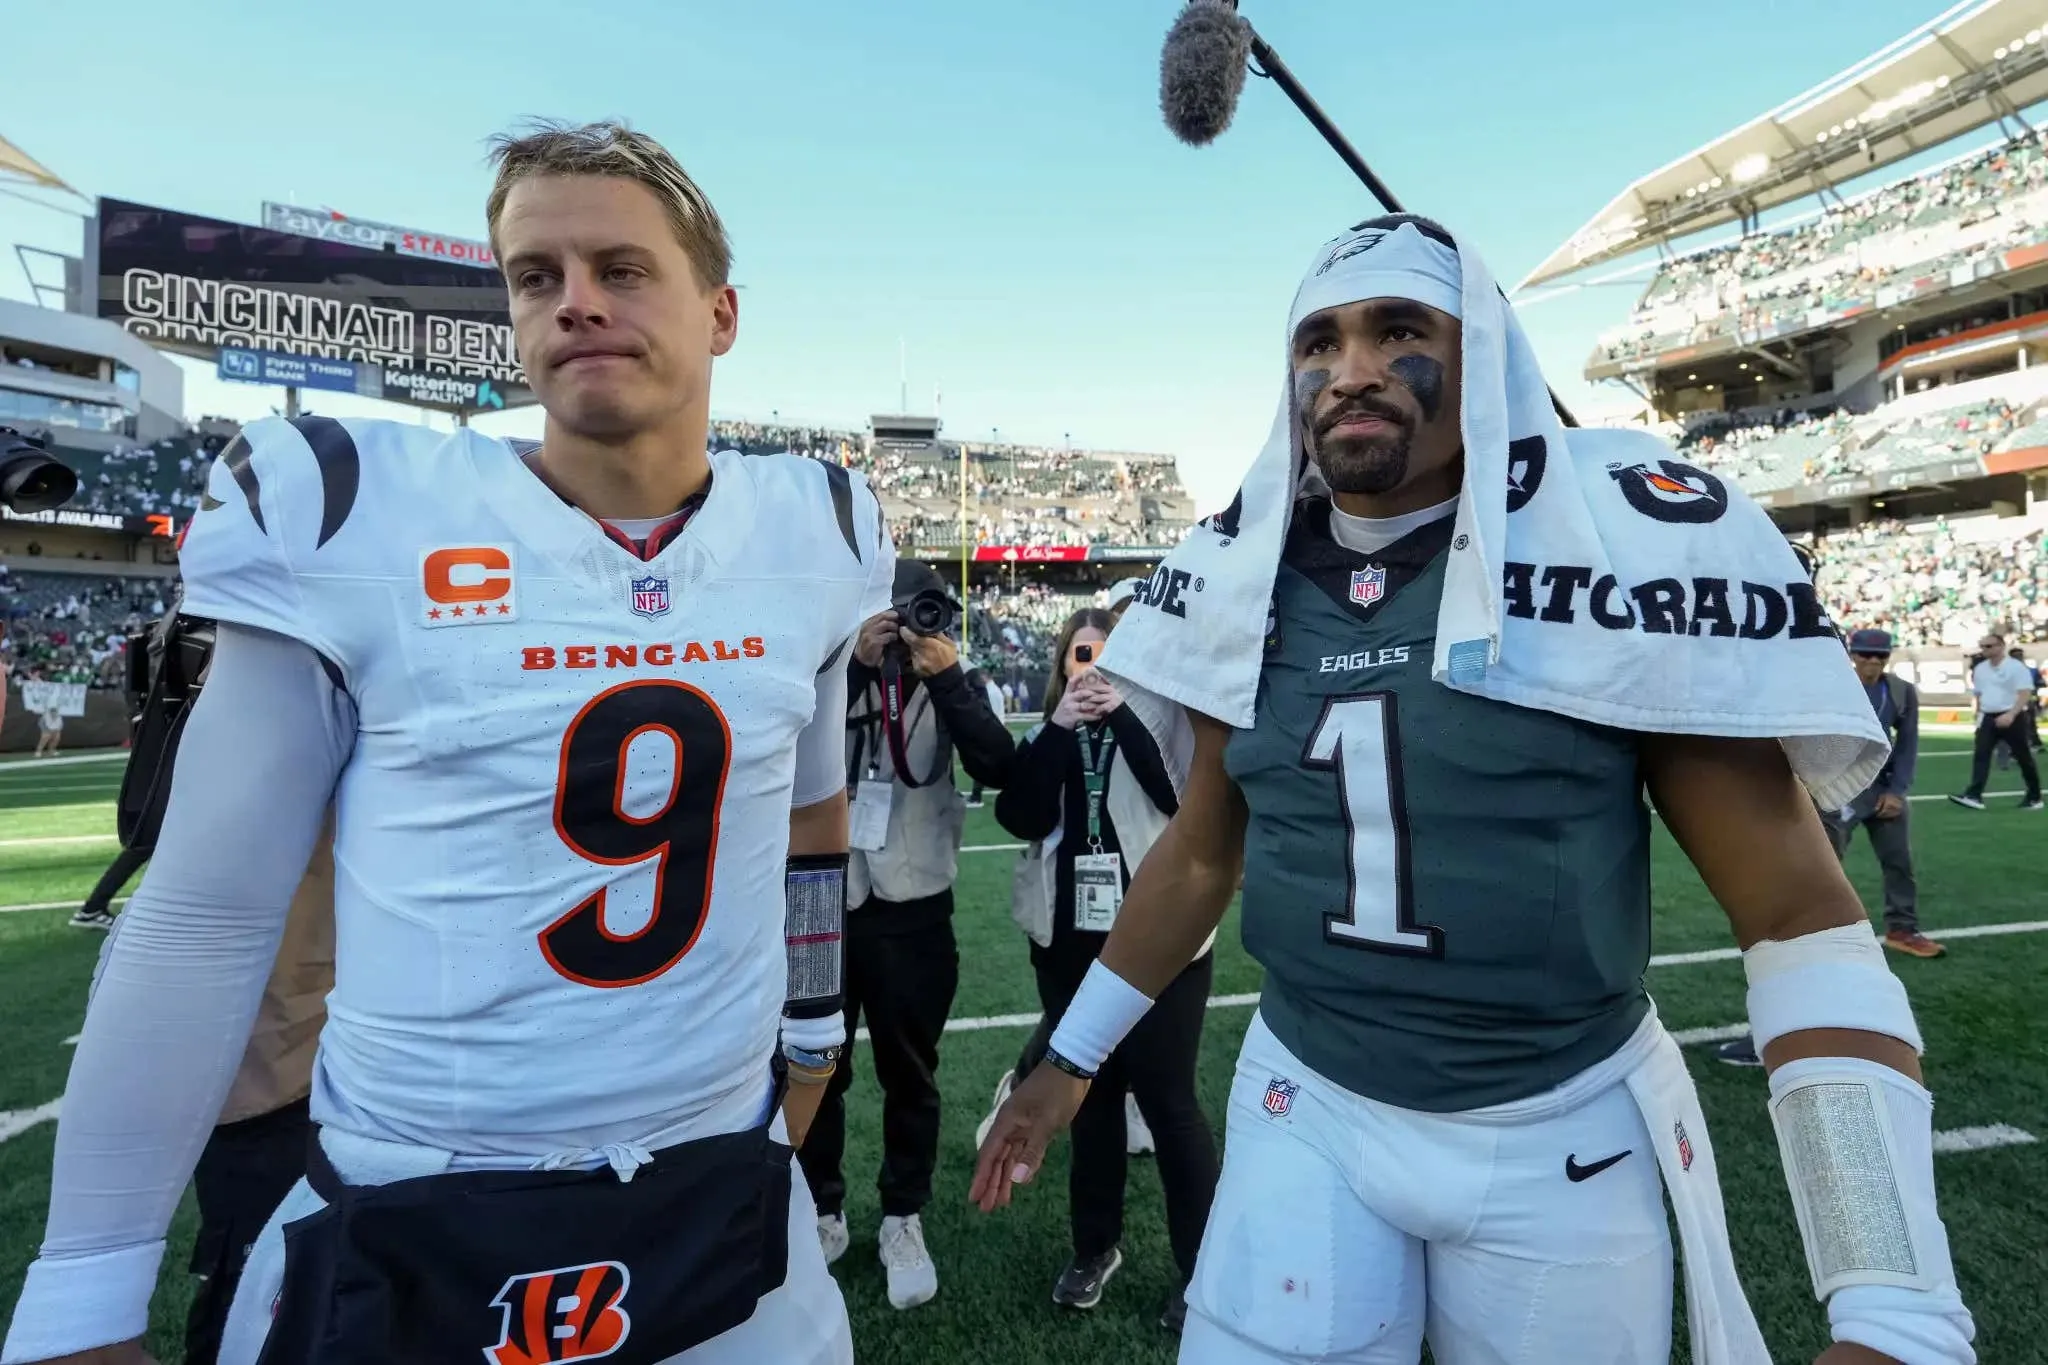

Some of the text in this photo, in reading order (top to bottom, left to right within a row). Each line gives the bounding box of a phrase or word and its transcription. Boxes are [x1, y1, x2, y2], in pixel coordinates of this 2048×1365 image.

[271, 207, 396, 246] Paycor
[123, 267, 414, 355] CINCINNATI
[265, 367, 306, 381] BANK
[266, 357, 353, 378] FIFTH THIRD
[385, 370, 477, 399] Kettering
[411, 388, 464, 405] HEALTH
[56, 510, 123, 529] AVAILABLE
[424, 547, 511, 604] C
[636, 593, 666, 612] NFL
[1356, 583, 1379, 599] NFL
[520, 636, 766, 671] BENGALS
[1319, 645, 1412, 673] EAGLES
[888, 684, 899, 721] Canon
[538, 678, 732, 988] 9
[1301, 689, 1446, 962] 1
